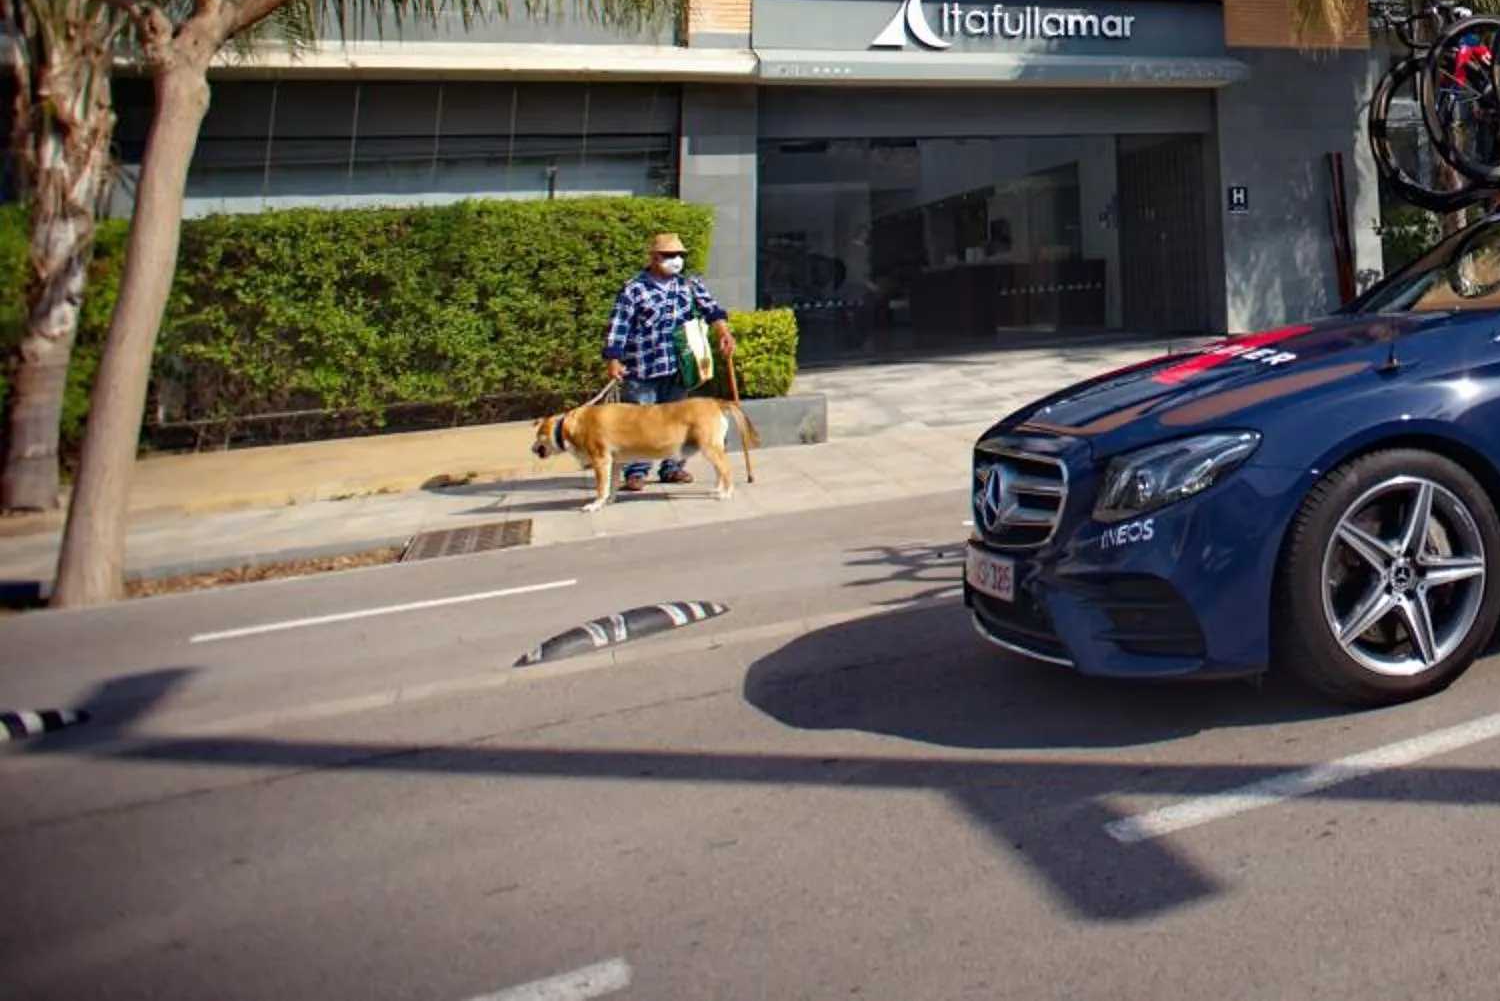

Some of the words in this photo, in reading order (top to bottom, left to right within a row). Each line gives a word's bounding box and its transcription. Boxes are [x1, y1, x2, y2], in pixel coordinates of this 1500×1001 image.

[942, 1, 1136, 38] Itafullamar
[1232, 188, 1245, 204] H
[1101, 518, 1155, 551] INEOS
